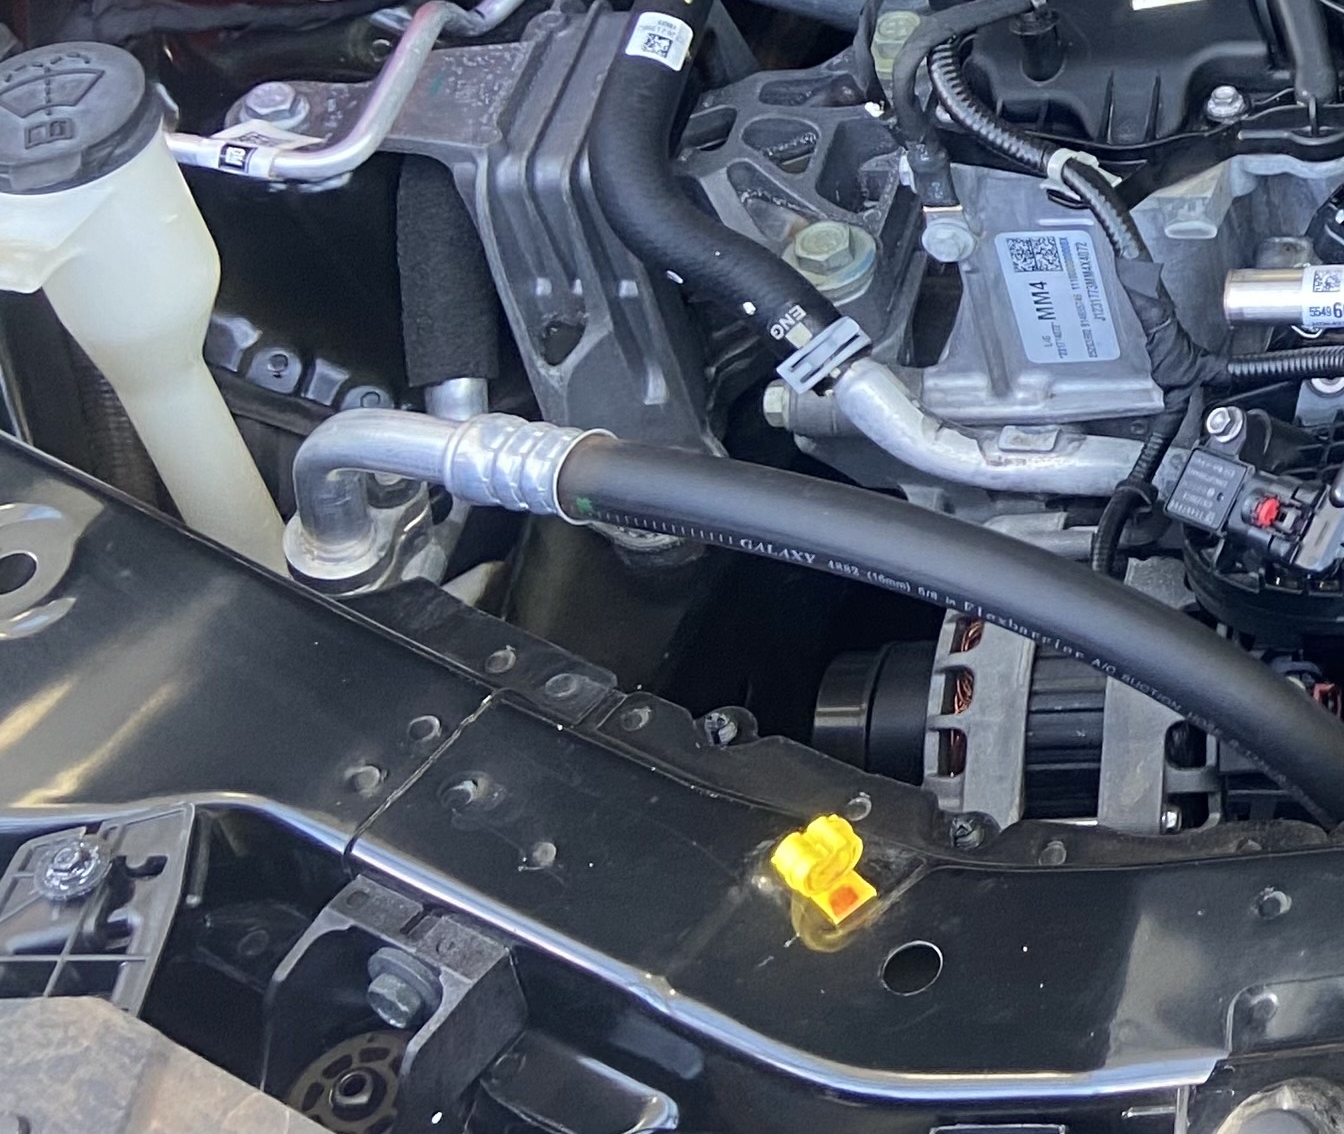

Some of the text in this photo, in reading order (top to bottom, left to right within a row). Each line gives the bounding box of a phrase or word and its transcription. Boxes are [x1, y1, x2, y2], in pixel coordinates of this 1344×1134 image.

[1028, 281, 1057, 321] MM4
[770, 304, 807, 340] ENG
[740, 538, 817, 565] GALAXY
